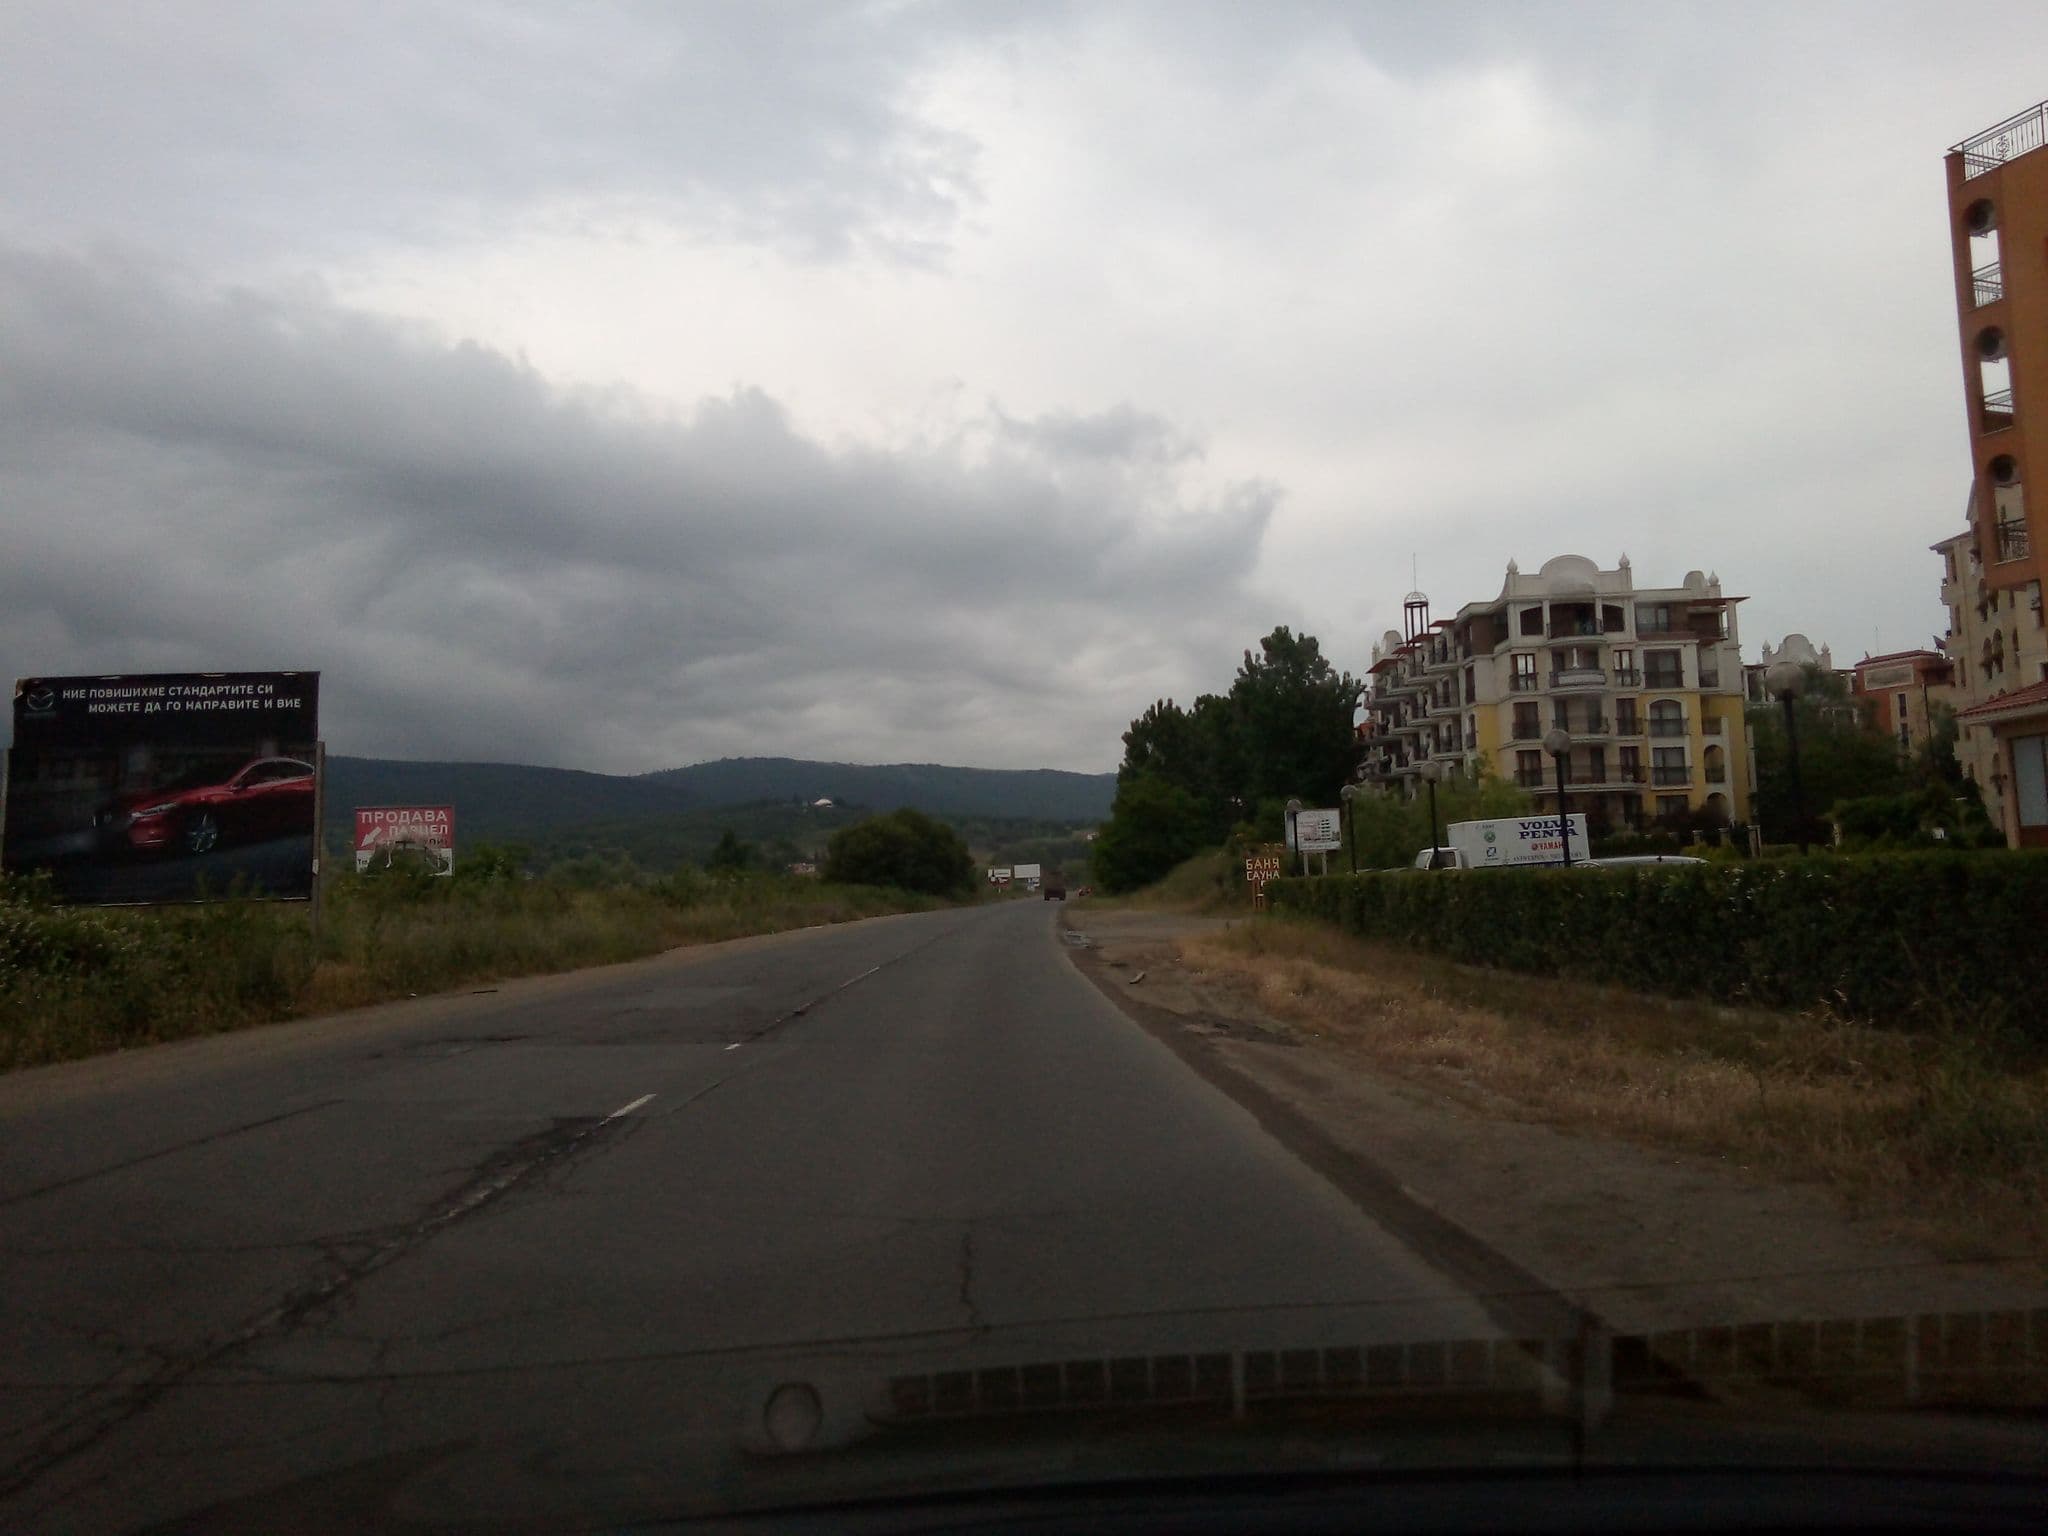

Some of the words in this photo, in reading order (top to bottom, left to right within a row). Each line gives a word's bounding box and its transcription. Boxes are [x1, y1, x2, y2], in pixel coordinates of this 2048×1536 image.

[63, 689, 86, 699] НИЕ
[89, 687, 165, 698] ПОВИШИХМЕ
[168, 685, 254, 697] СТАНДАРТИТЕ
[257, 684, 274, 694] СИ
[88, 702, 140, 713] МОЖЕТЕ
[144, 702, 161, 713] ДА
[166, 701, 181, 711] ГО
[185, 700, 260, 711] НАПРАВИТЕ
[264, 699, 272, 709] И
[277, 698, 302, 708] ВИЕ
[361, 810, 448, 825] ПРОДАВА
[1518, 818, 1575, 830] VOLVO
[1537, 840, 1565, 851] YAMAH
[1246, 856, 1280, 870] БАНЯ
[1246, 870, 1280, 881] САУНА
